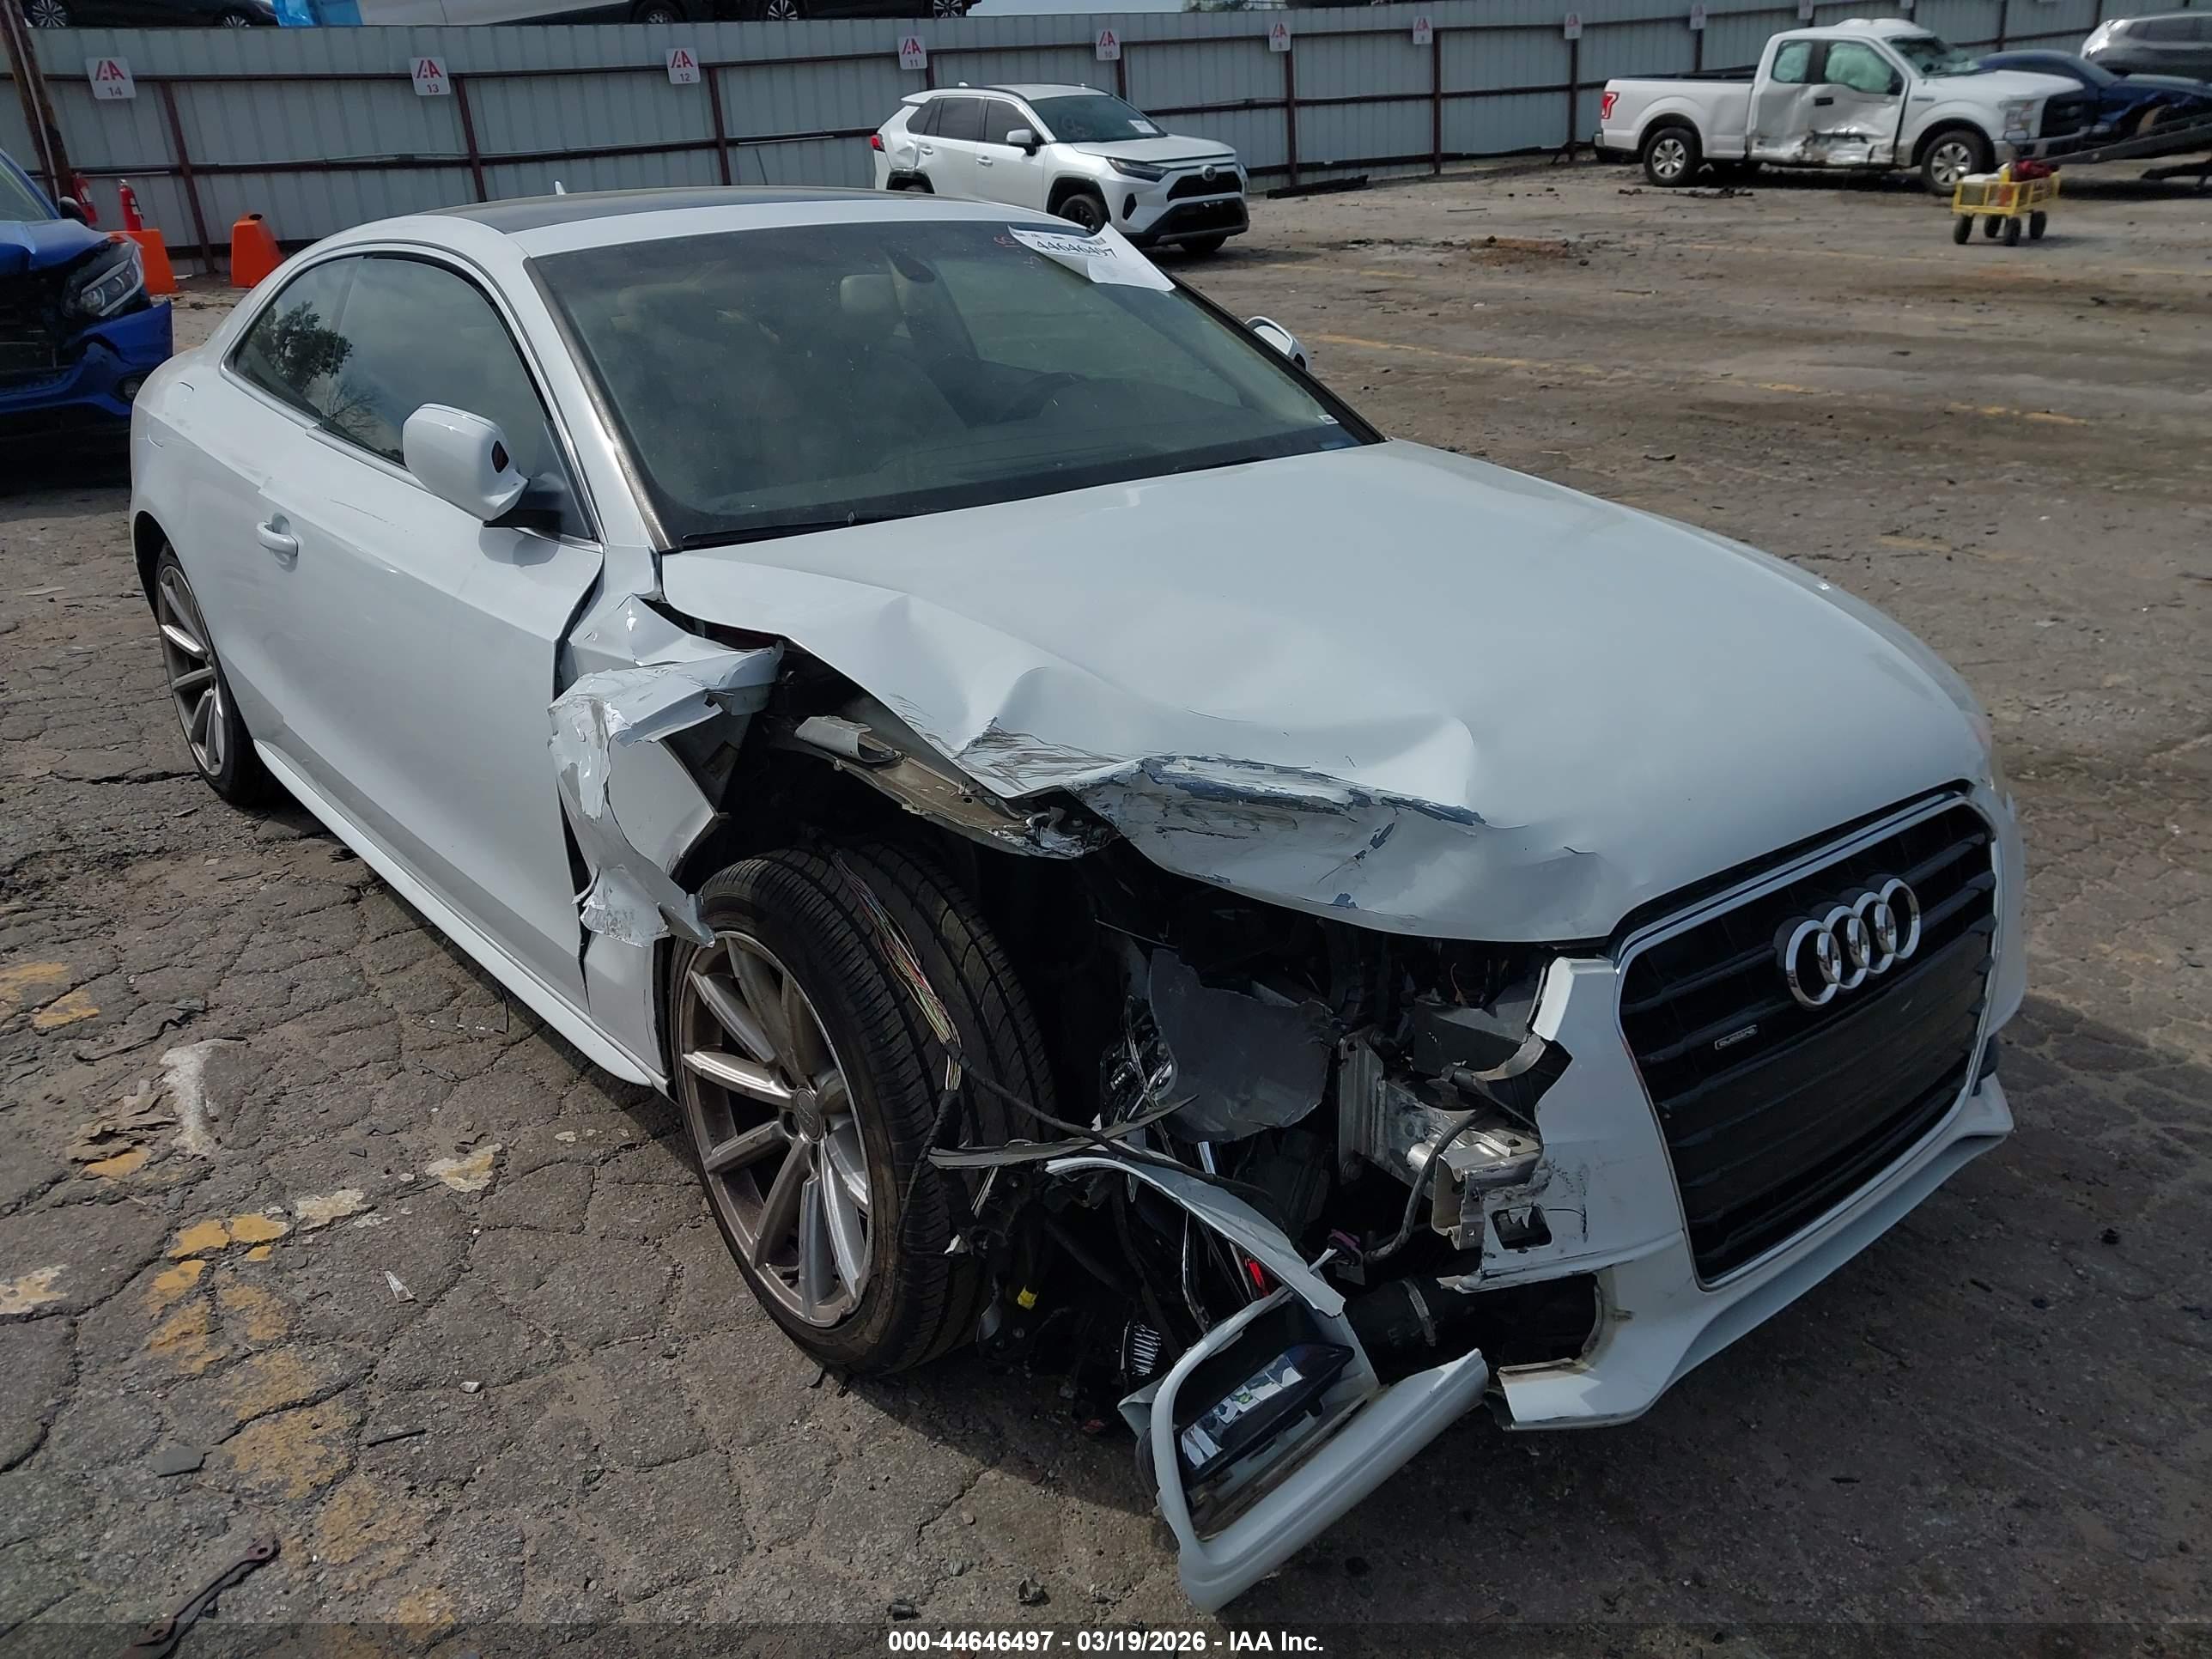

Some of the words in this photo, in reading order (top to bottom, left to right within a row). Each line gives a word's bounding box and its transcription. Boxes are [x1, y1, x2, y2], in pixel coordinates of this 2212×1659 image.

[679, 72, 692, 82] 12
[107, 86, 123, 97] 14
[426, 83, 440, 94] 13
